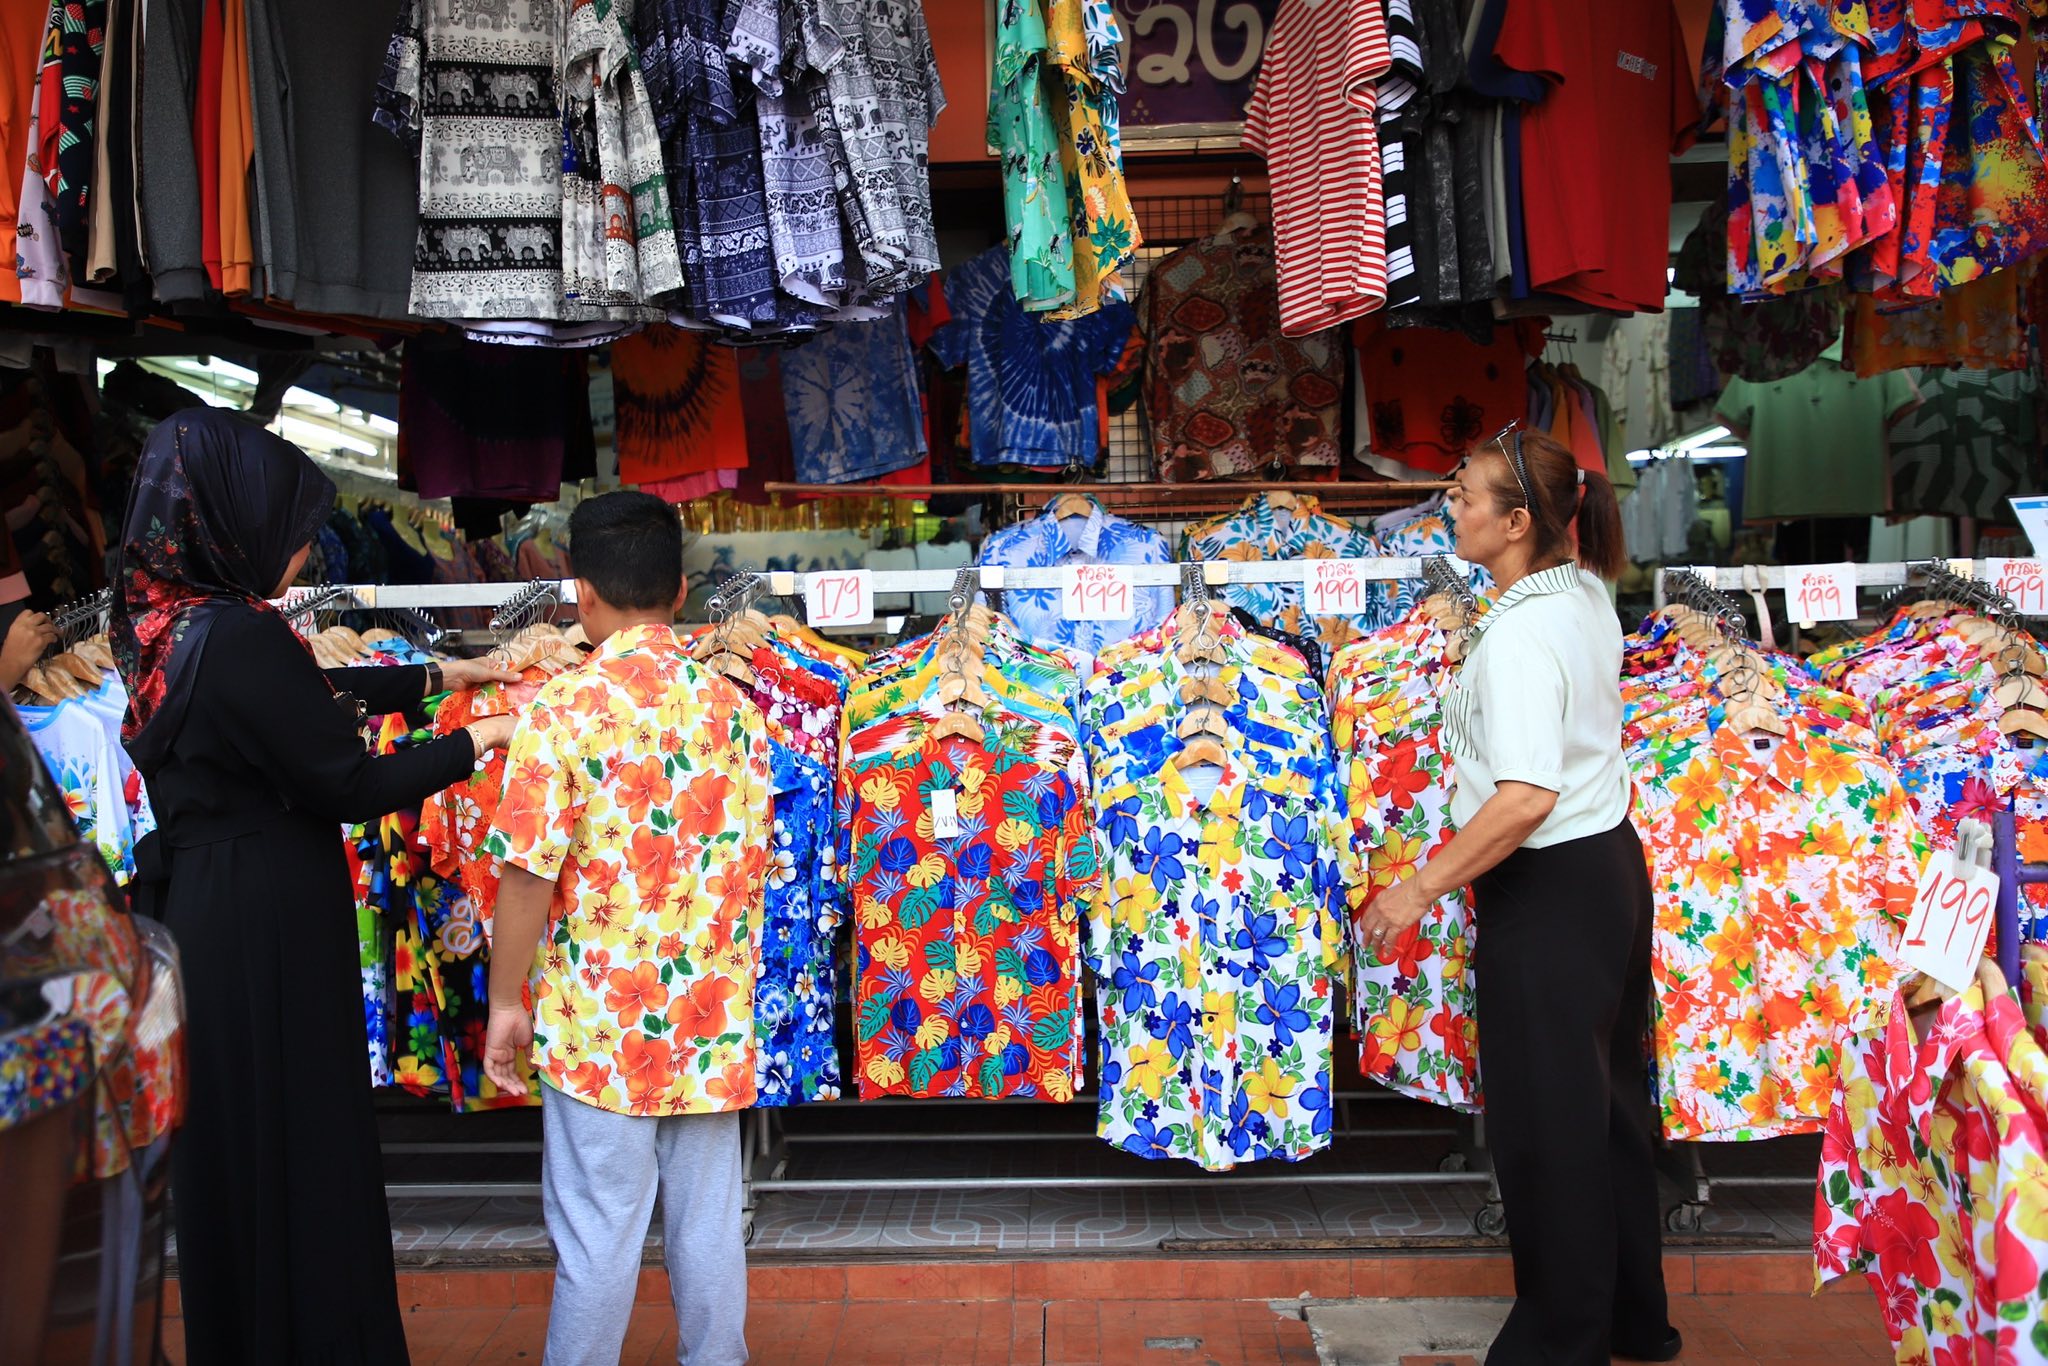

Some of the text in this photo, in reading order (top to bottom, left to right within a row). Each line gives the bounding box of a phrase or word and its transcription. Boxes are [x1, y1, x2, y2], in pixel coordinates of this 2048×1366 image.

[1316, 561, 1356, 578] ตัวละ
[815, 575, 861, 620] 179
[1071, 581, 1127, 613] 199
[1313, 577, 1360, 612] 199
[1797, 586, 1841, 619] 199
[1994, 575, 2044, 611] 199
[1906, 870, 1990, 969] 199
